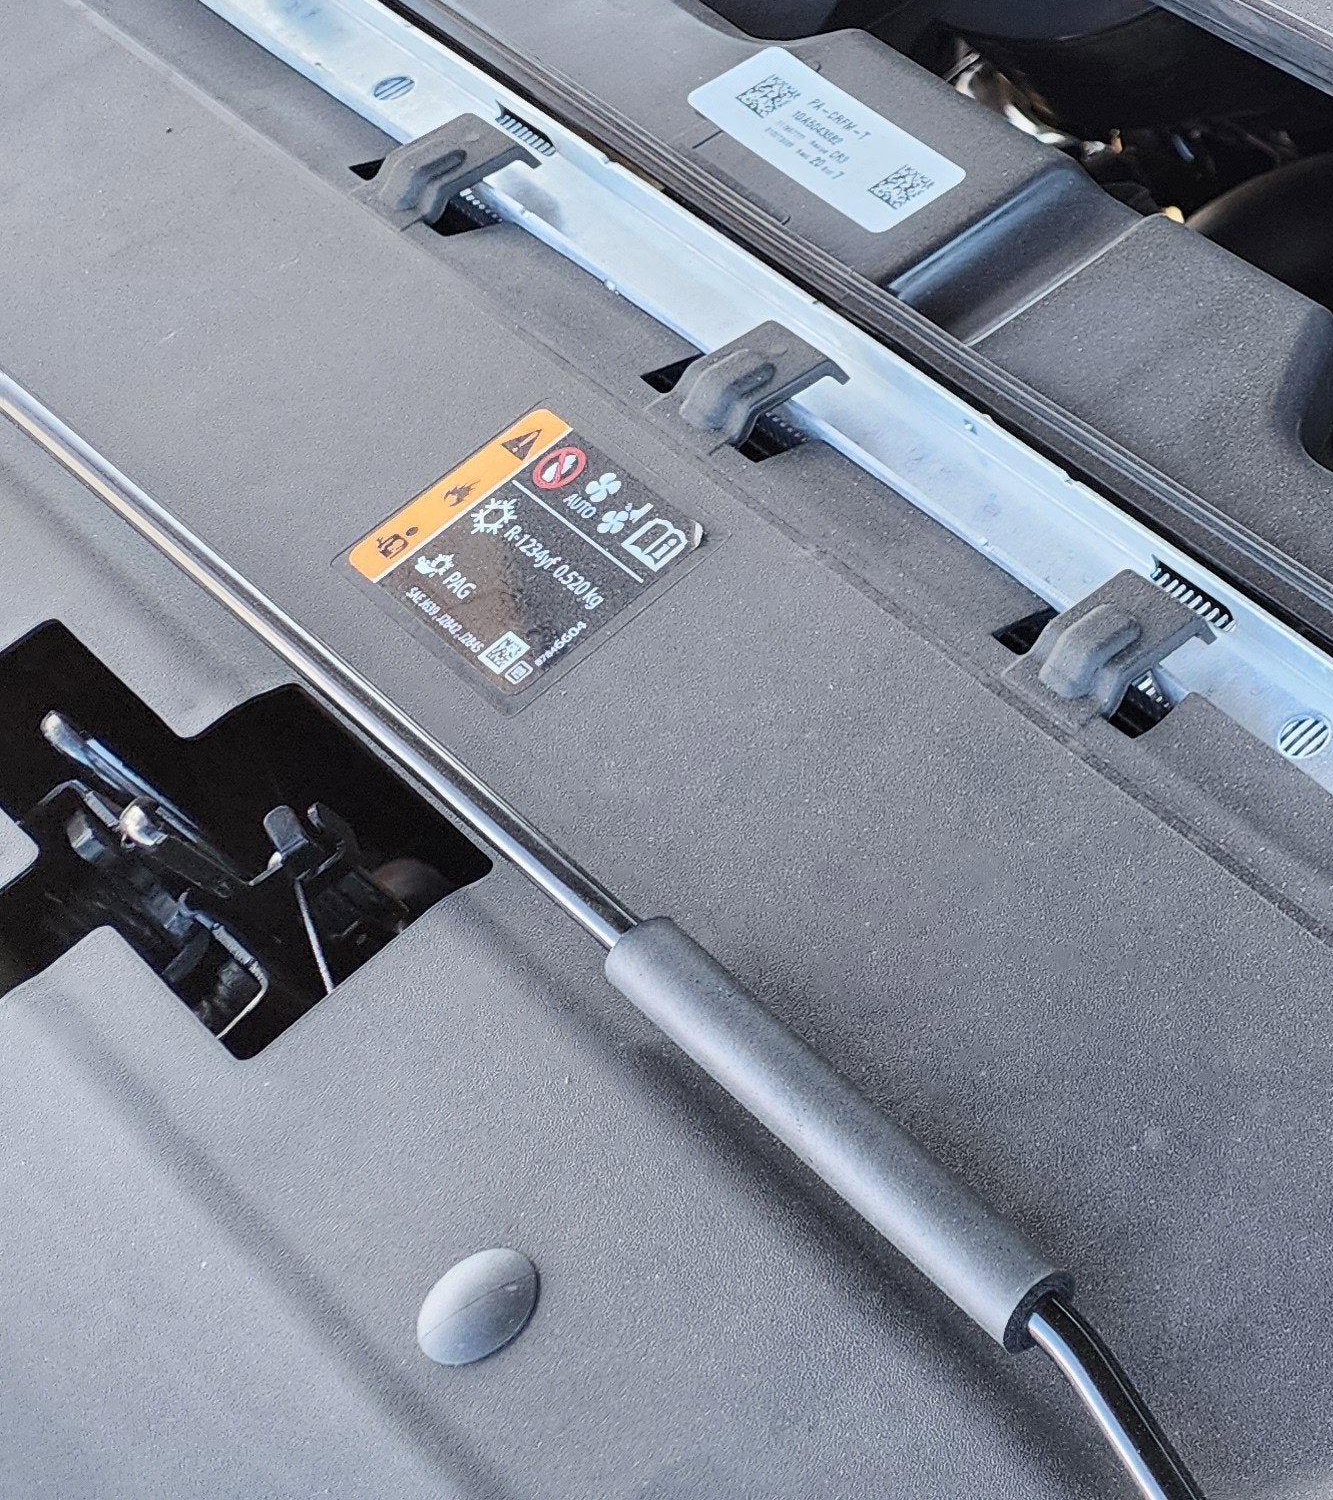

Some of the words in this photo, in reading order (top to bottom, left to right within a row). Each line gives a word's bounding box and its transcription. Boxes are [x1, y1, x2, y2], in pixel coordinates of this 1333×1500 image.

[563, 493, 597, 519] AUTO
[503, 525, 561, 570] R-1234yf
[553, 564, 591, 595] 0.520
[582, 586, 605, 610] kg
[406, 587, 426, 607] SAE
[442, 571, 477, 600] PAG
